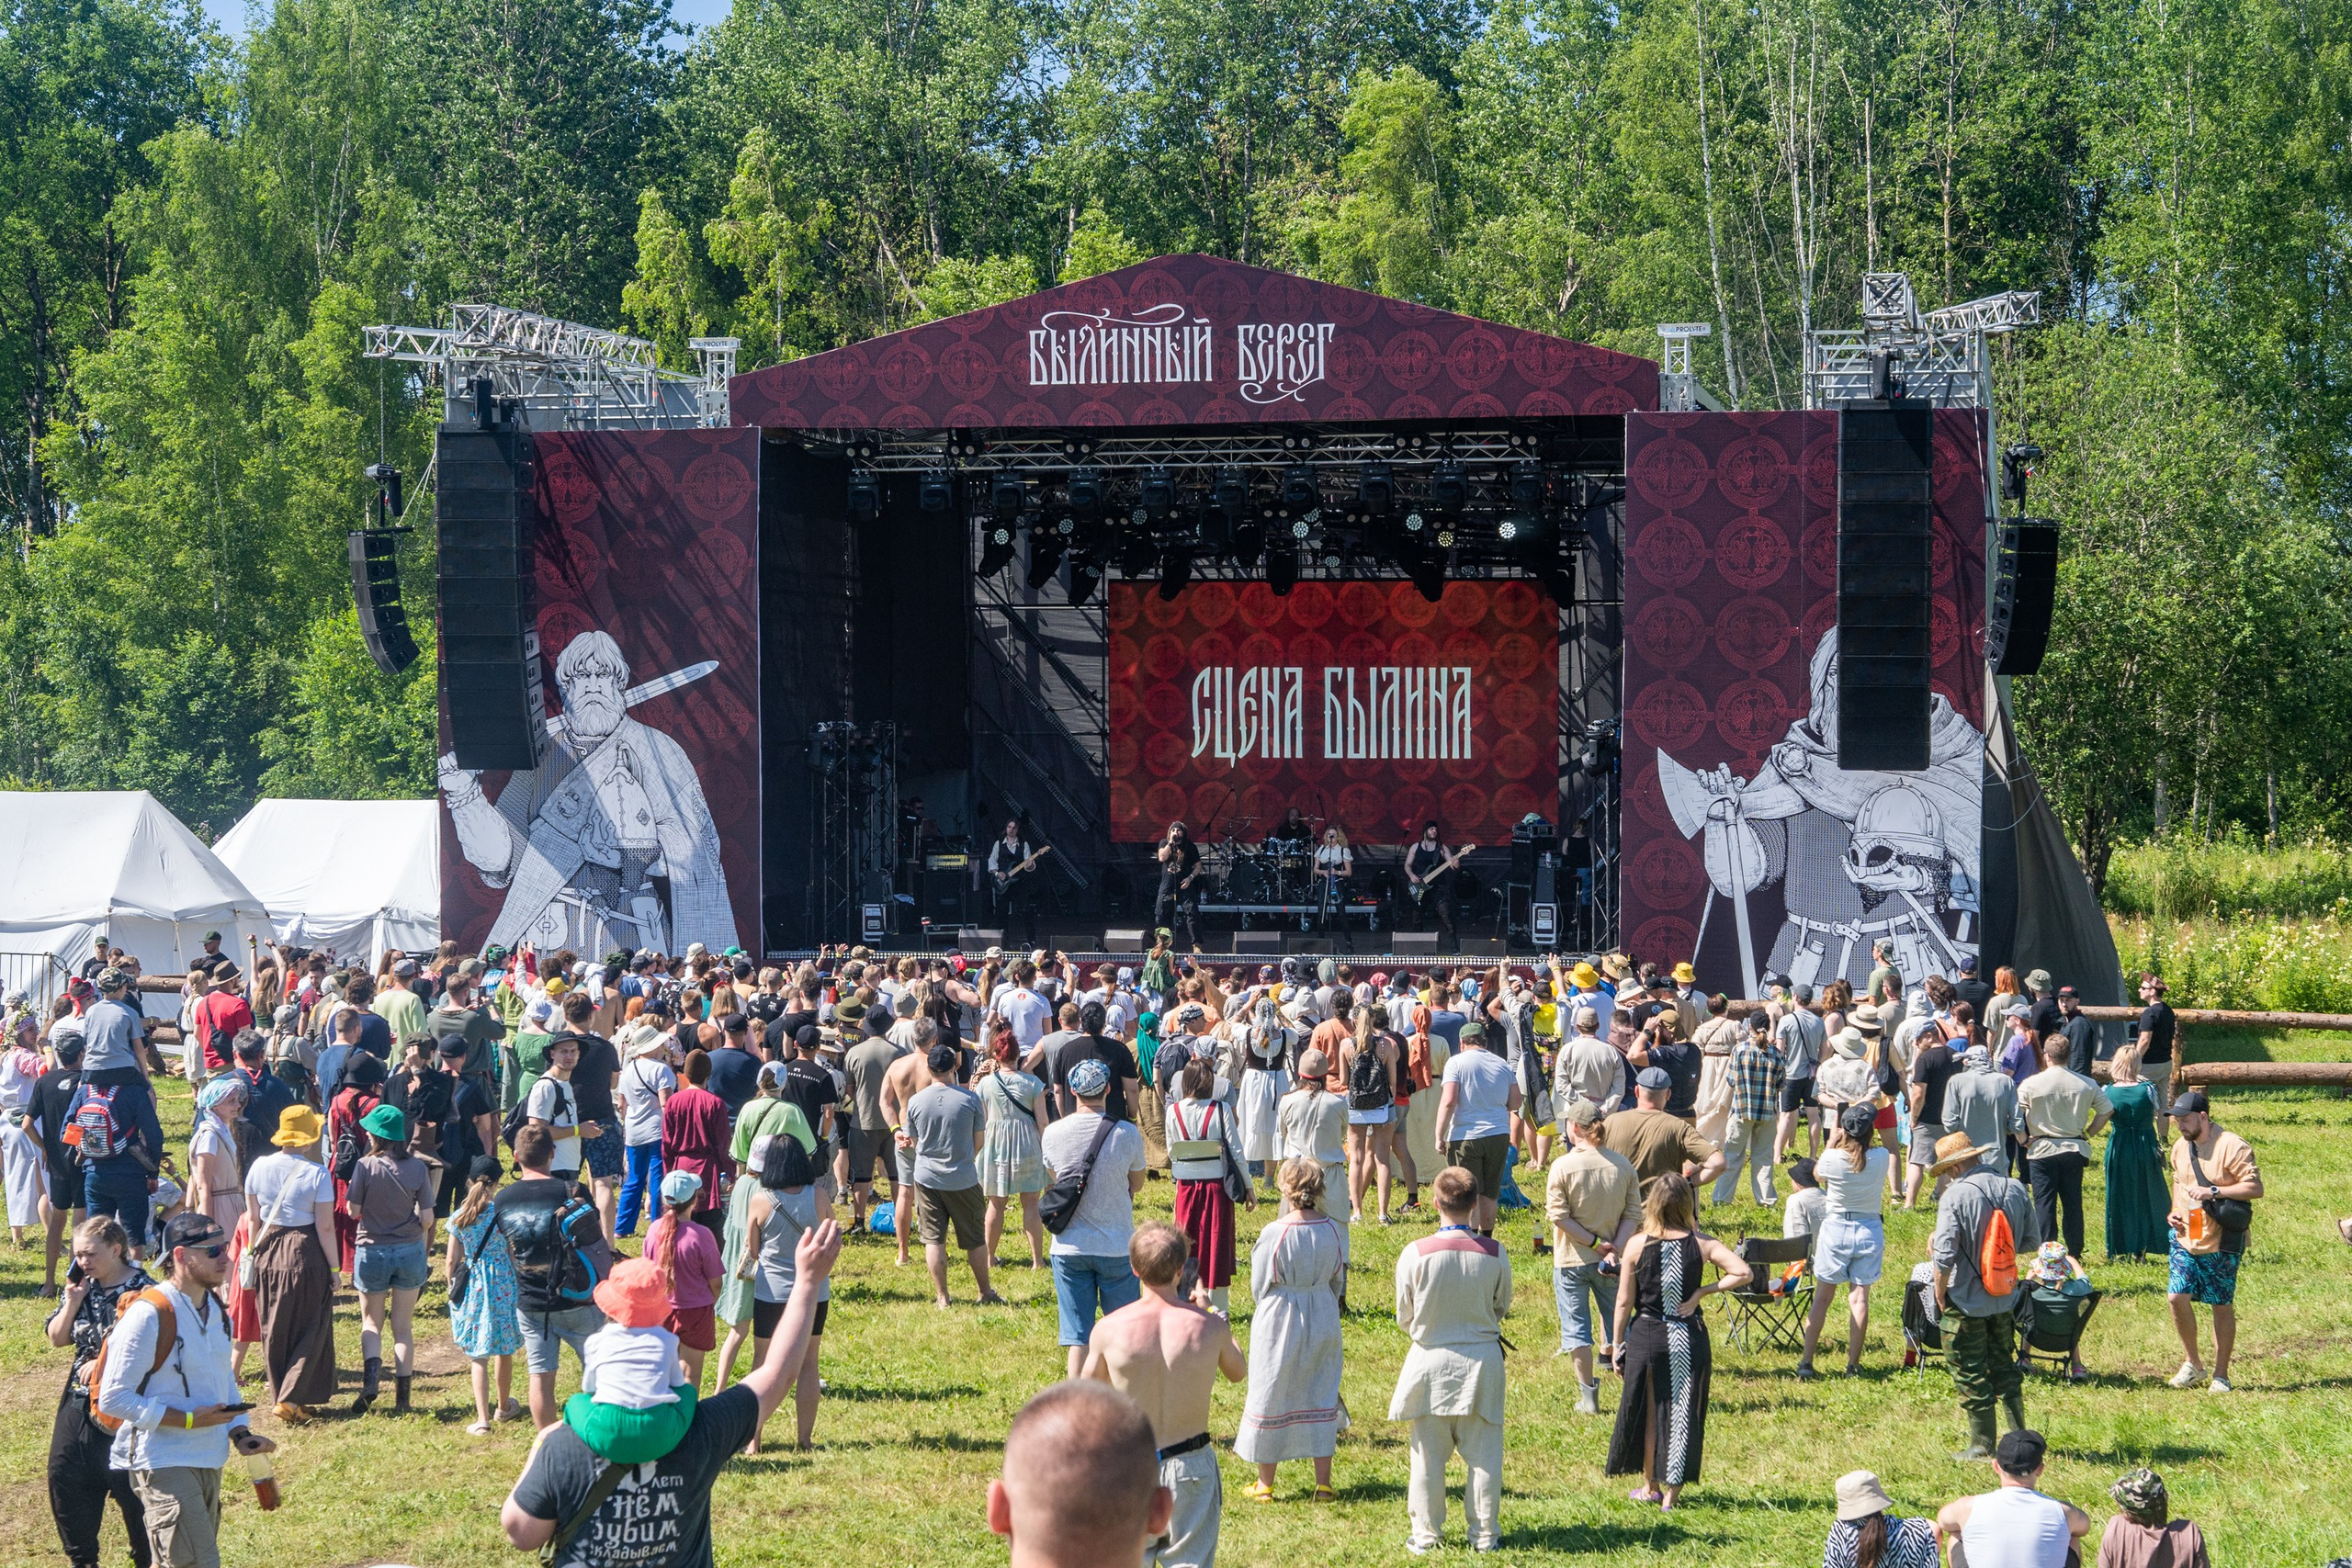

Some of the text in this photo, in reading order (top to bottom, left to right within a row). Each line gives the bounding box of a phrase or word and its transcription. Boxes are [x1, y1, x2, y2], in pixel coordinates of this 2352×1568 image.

[1029, 305, 1335, 402] БЫЛИННЫЙ БЕРЕГ
[1192, 666, 1472, 768] СЦЕНА БЫЛИНА
[593, 1488, 684, 1518] нём
[651, 1475, 684, 1488] лет
